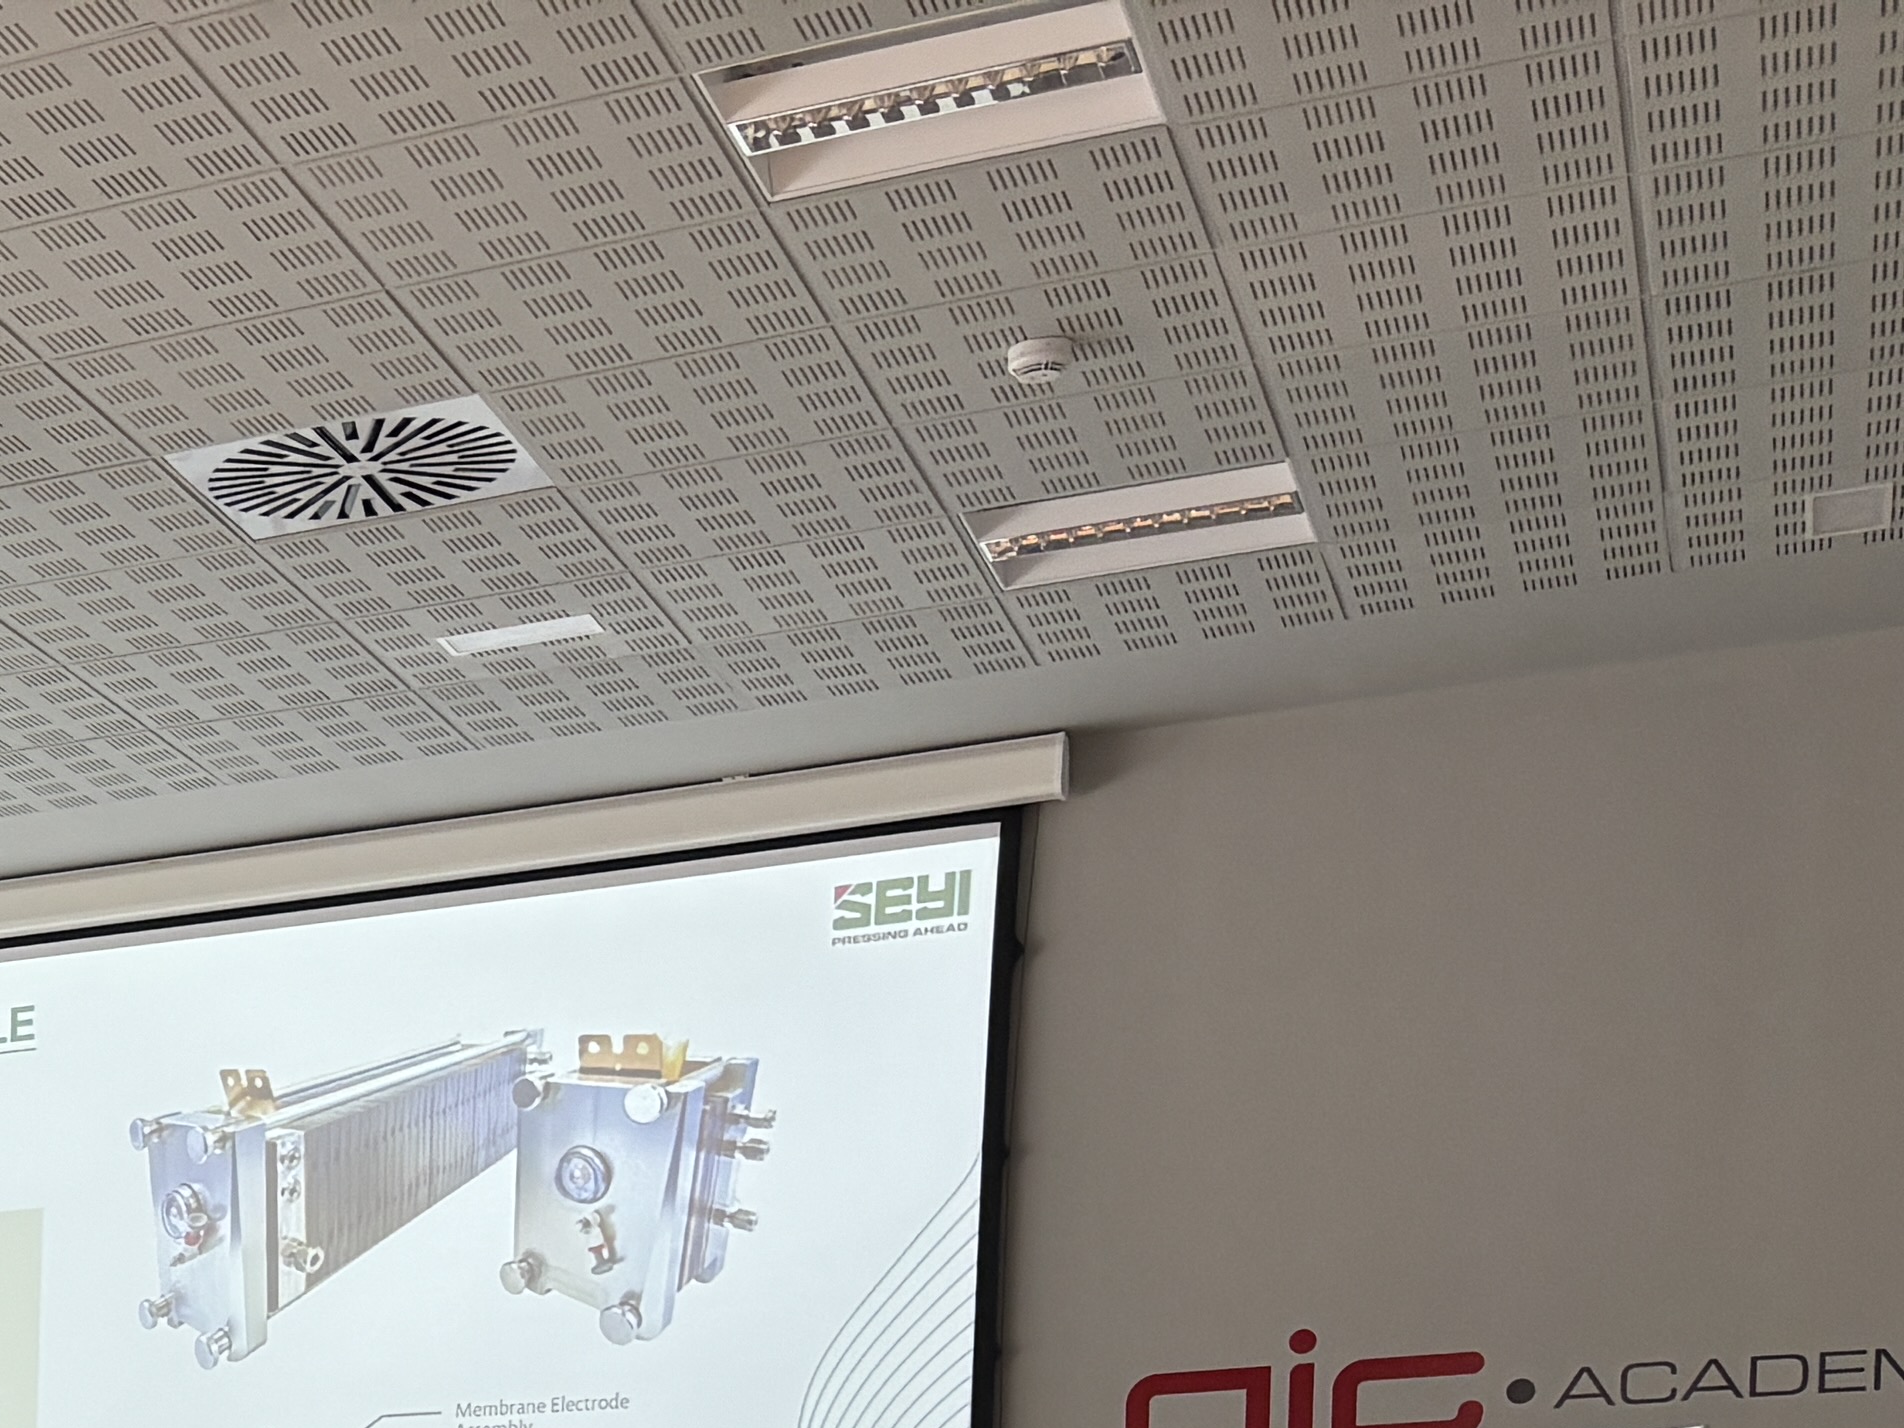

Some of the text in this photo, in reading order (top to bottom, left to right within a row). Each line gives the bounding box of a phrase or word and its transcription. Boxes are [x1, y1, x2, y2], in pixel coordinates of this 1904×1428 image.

[833, 869, 971, 930] SEYI
[831, 922, 968, 946] PRESSING AHEAD
[455, 1392, 630, 1418] Membrane Electrode
